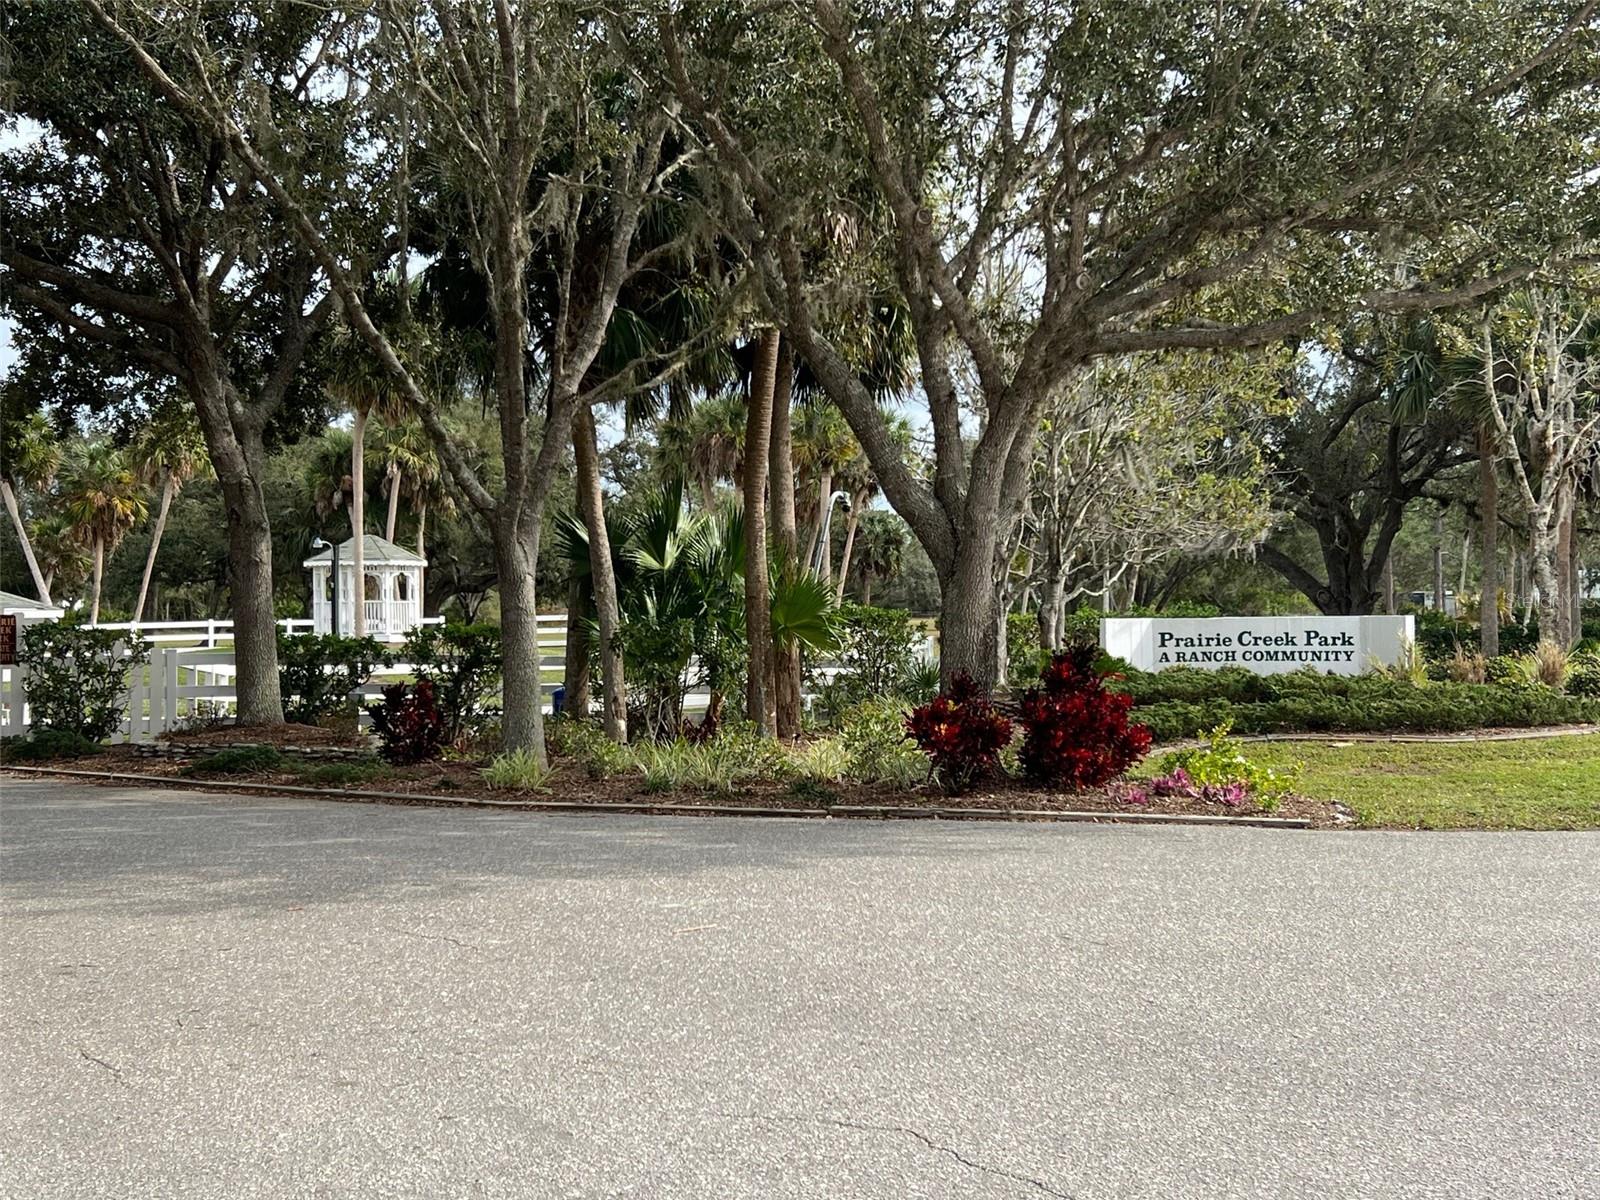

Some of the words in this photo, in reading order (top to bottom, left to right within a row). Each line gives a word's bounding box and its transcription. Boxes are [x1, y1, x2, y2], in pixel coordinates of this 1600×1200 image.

[1158, 632, 1232, 648] Prairie
[1237, 631, 1298, 647] Creek
[1304, 630, 1355, 646] Park
[1159, 651, 1170, 663] A
[1175, 650, 1237, 662] RANCH
[1242, 650, 1355, 662] COMMUNITY
